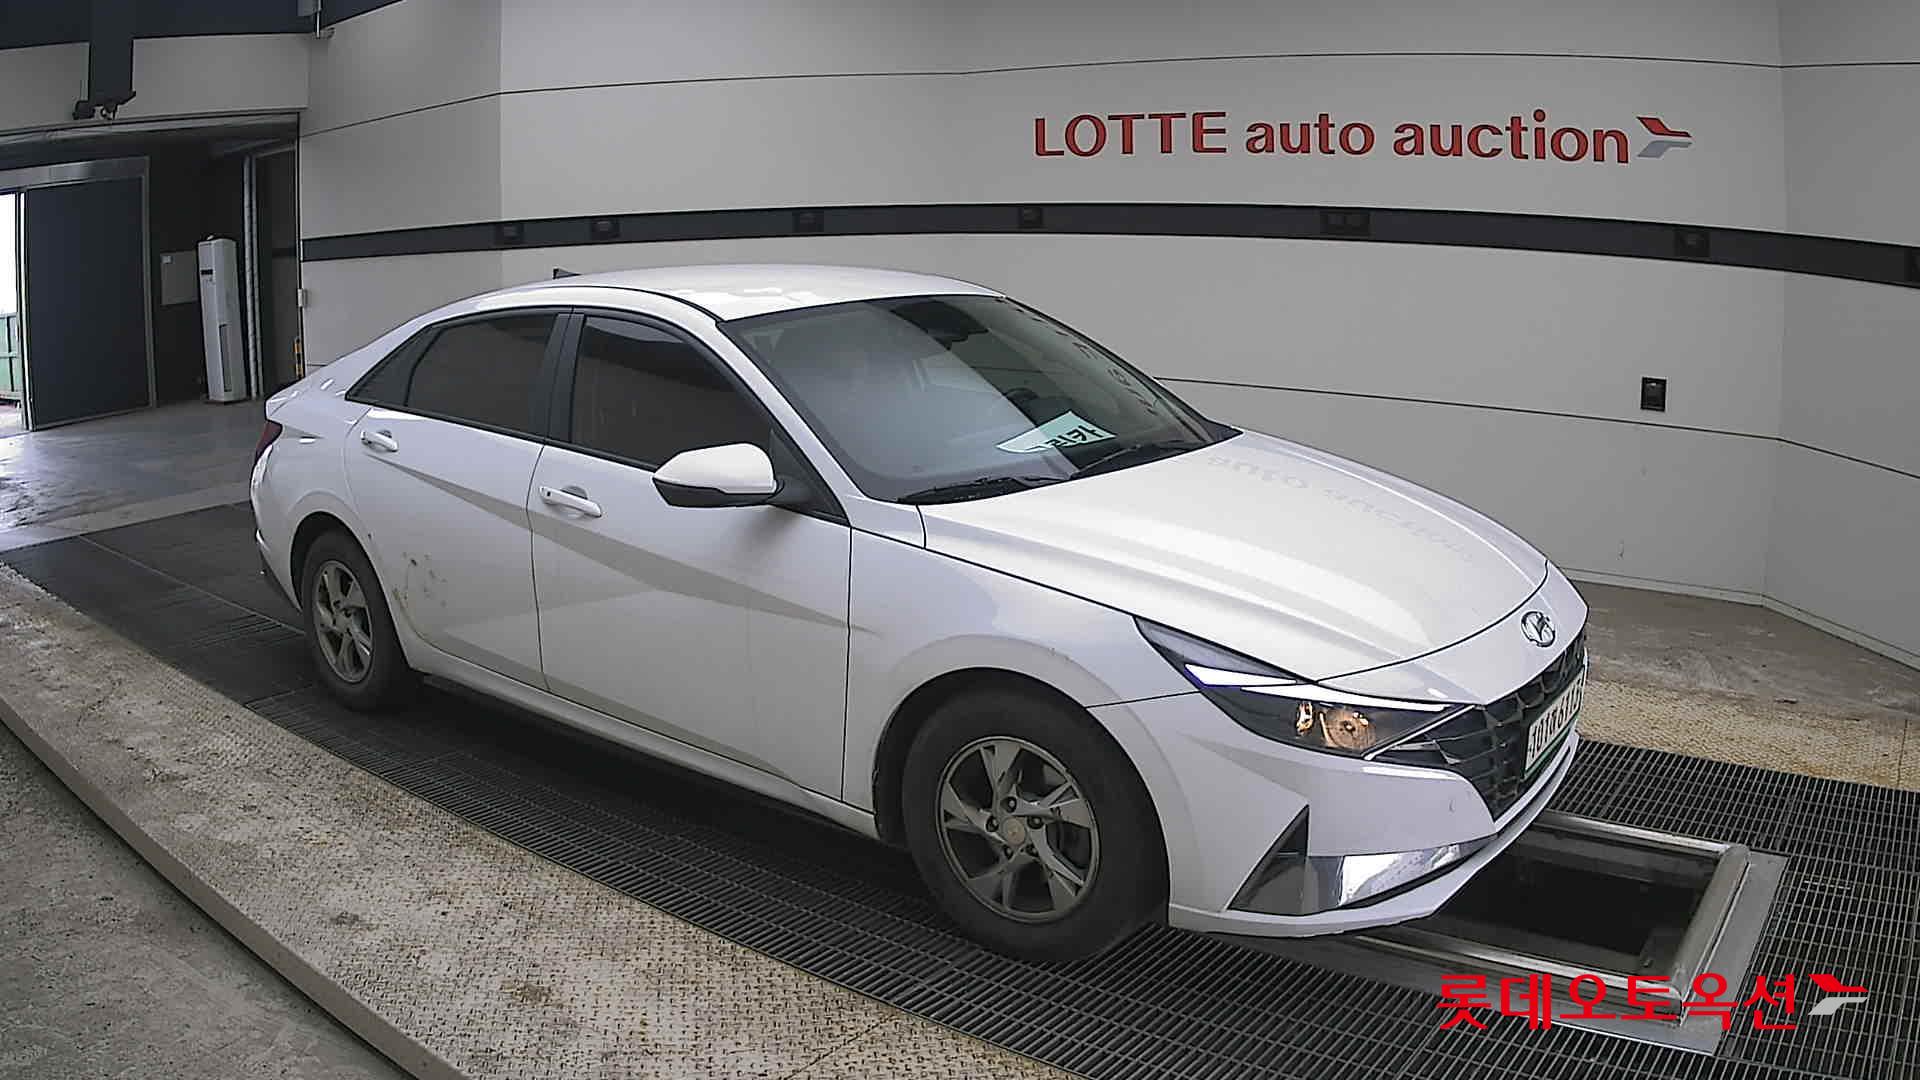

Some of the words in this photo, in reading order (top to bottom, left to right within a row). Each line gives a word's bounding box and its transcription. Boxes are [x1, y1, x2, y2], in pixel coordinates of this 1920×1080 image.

[1035, 112, 1227, 156] LOTTE
[1246, 113, 1375, 154] auto
[1394, 110, 1629, 163] auction
